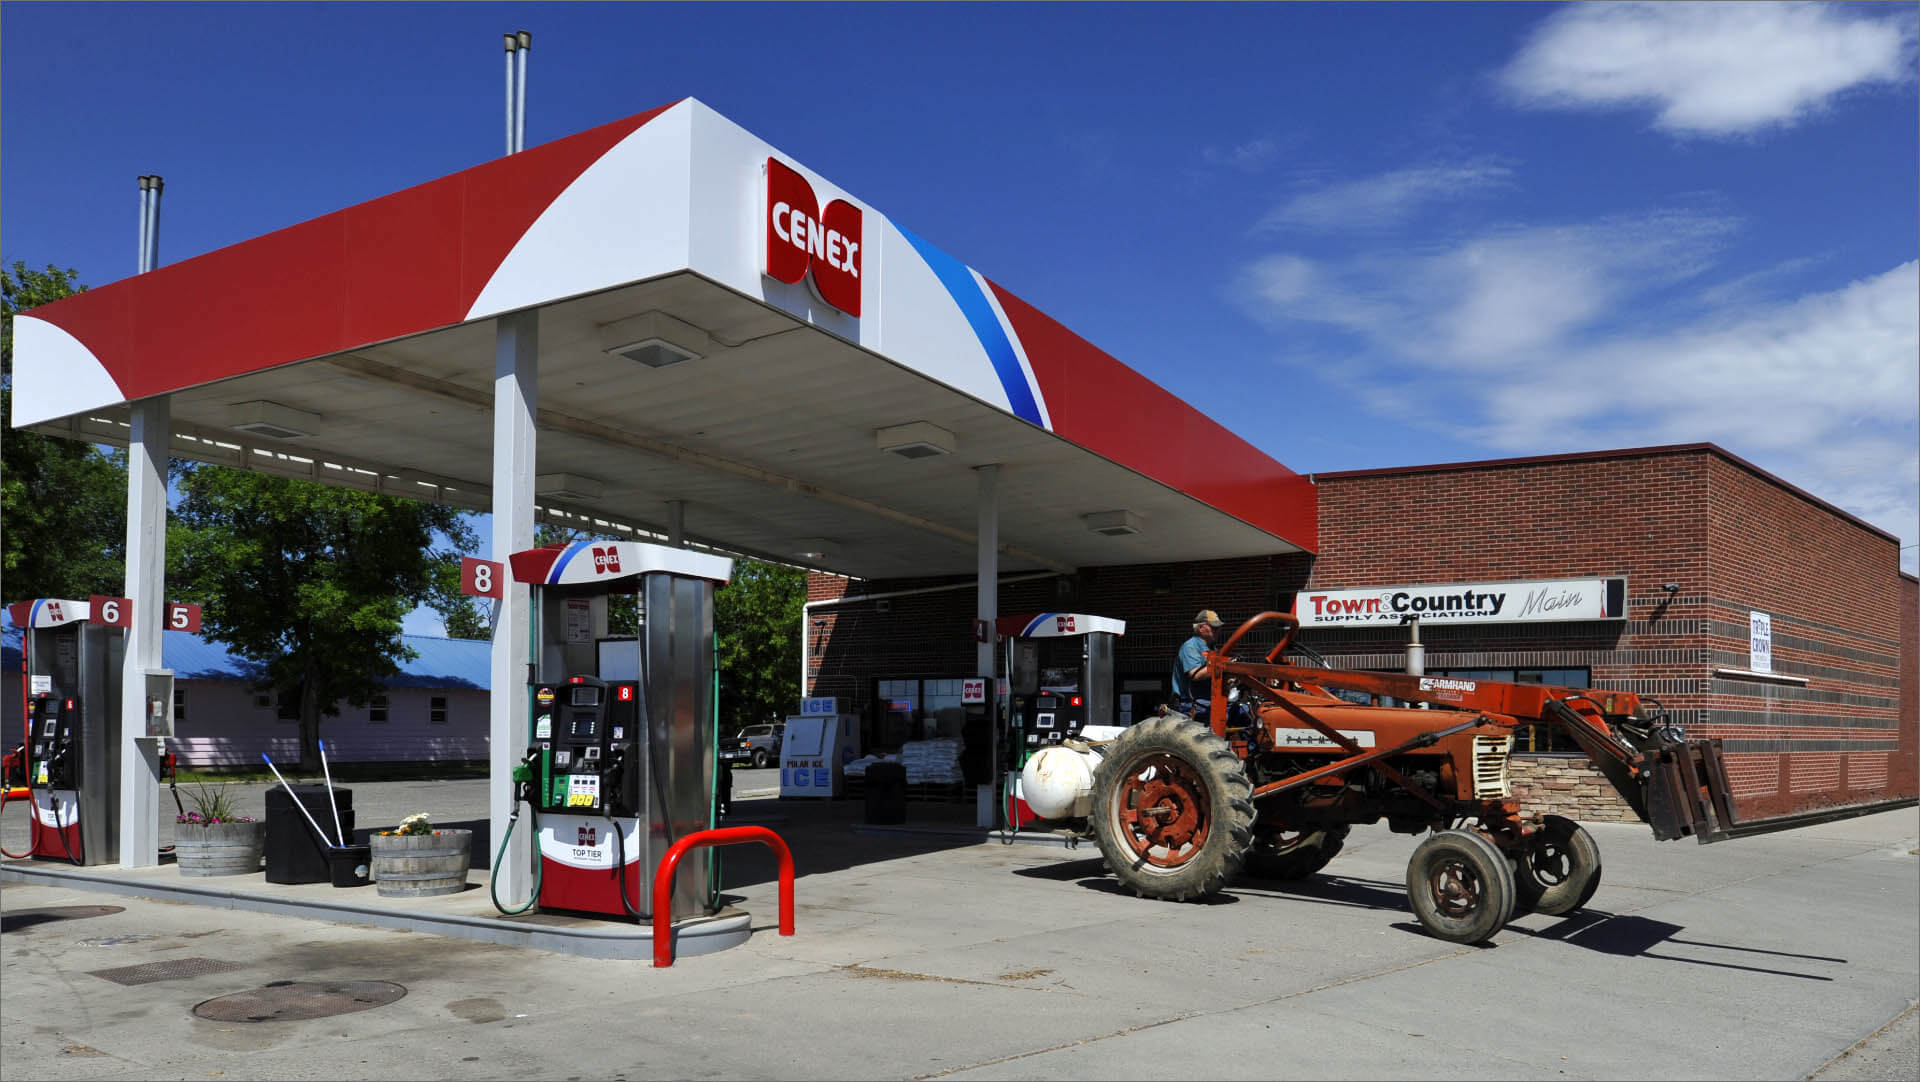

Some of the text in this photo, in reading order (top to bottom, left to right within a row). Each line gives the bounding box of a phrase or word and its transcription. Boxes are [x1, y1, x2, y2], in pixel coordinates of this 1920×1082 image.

[772, 201, 859, 279] CENEX
[595, 555, 620, 566] CENEX
[474, 564, 492, 593] 8
[1517, 585, 1583, 618] Main
[102, 600, 120, 623] 6
[171, 607, 189, 629] 5
[1314, 614, 1374, 622] SUPPLY
[1752, 637, 1770, 654] CROWN
[622, 687, 630, 699] 8
[803, 699, 833, 713] ICE
[1286, 735, 1359, 745] FARM
[783, 767, 830, 788] ICE
[572, 848, 602, 858] TOP TIER
